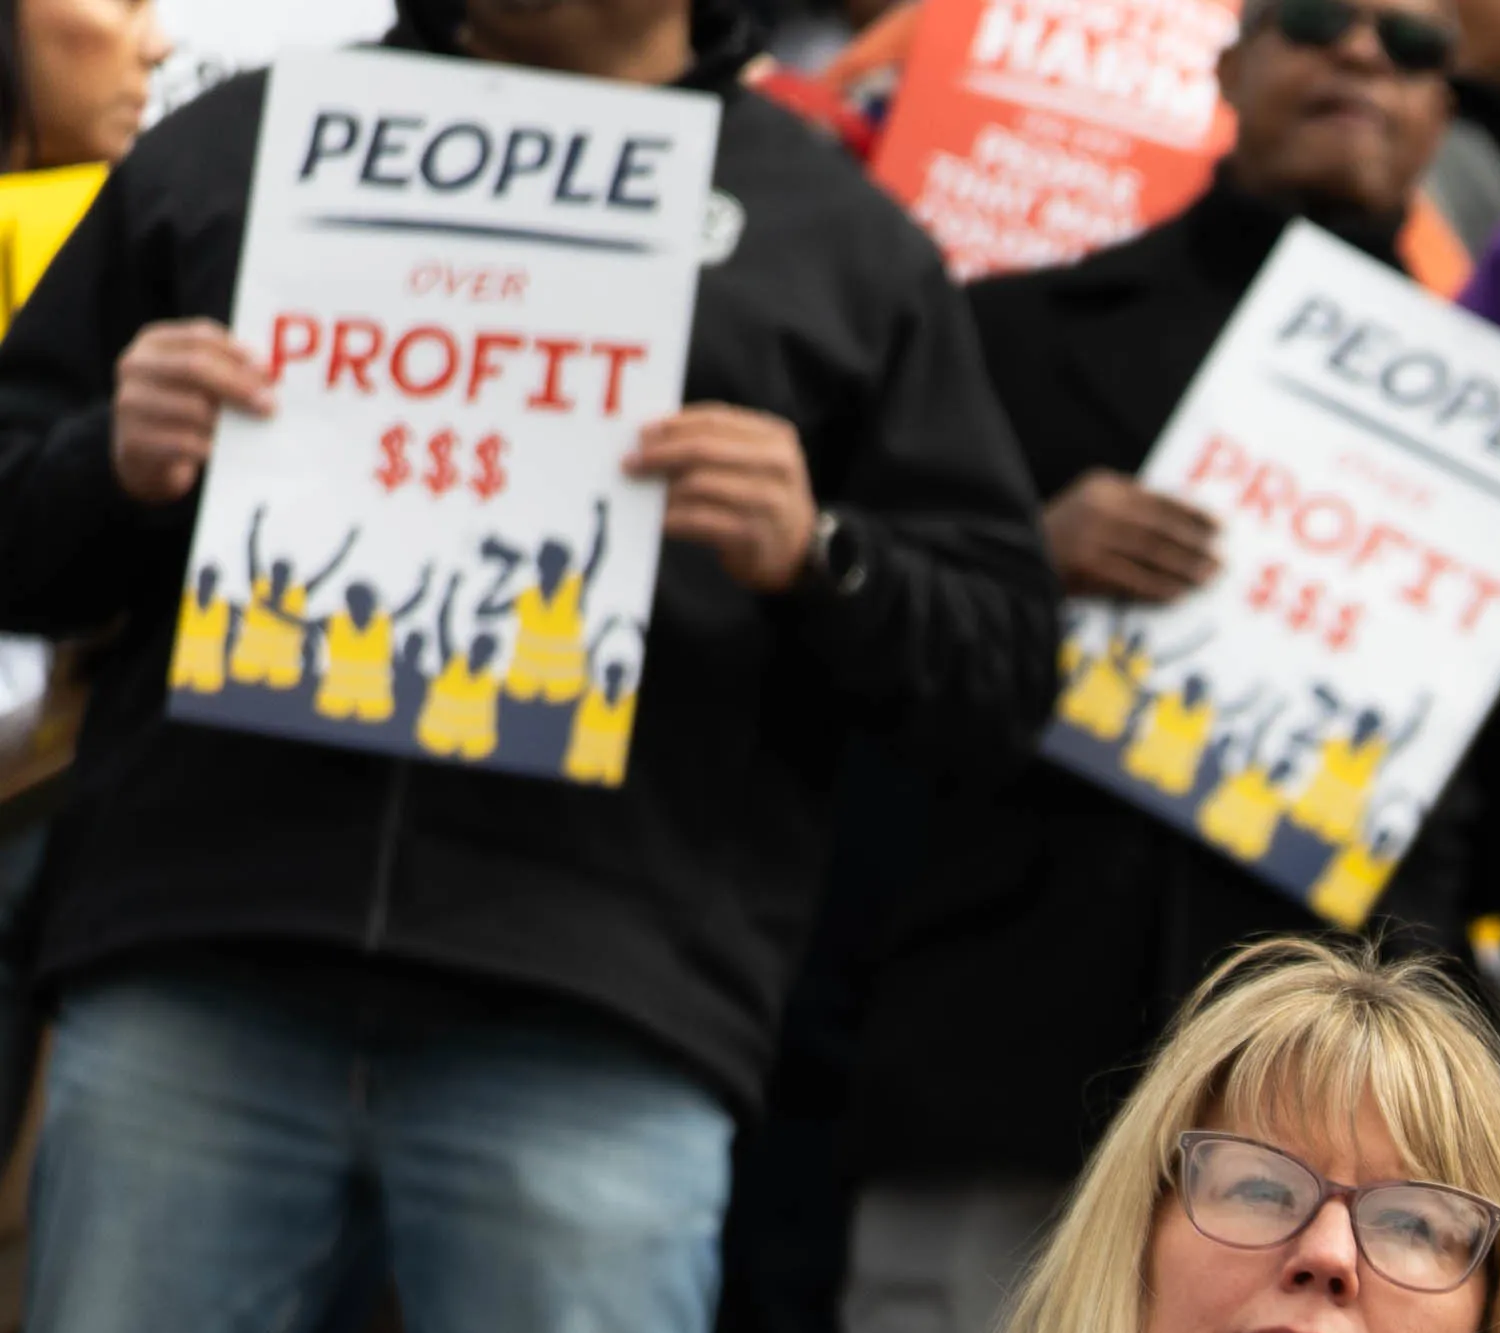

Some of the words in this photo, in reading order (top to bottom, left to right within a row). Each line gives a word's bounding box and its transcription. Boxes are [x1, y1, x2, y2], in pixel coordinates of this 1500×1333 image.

[298, 110, 672, 211] PEOPLE
[407, 261, 531, 304] OVER
[267, 312, 649, 415] PROFIT
[373, 425, 509, 501] $$$
